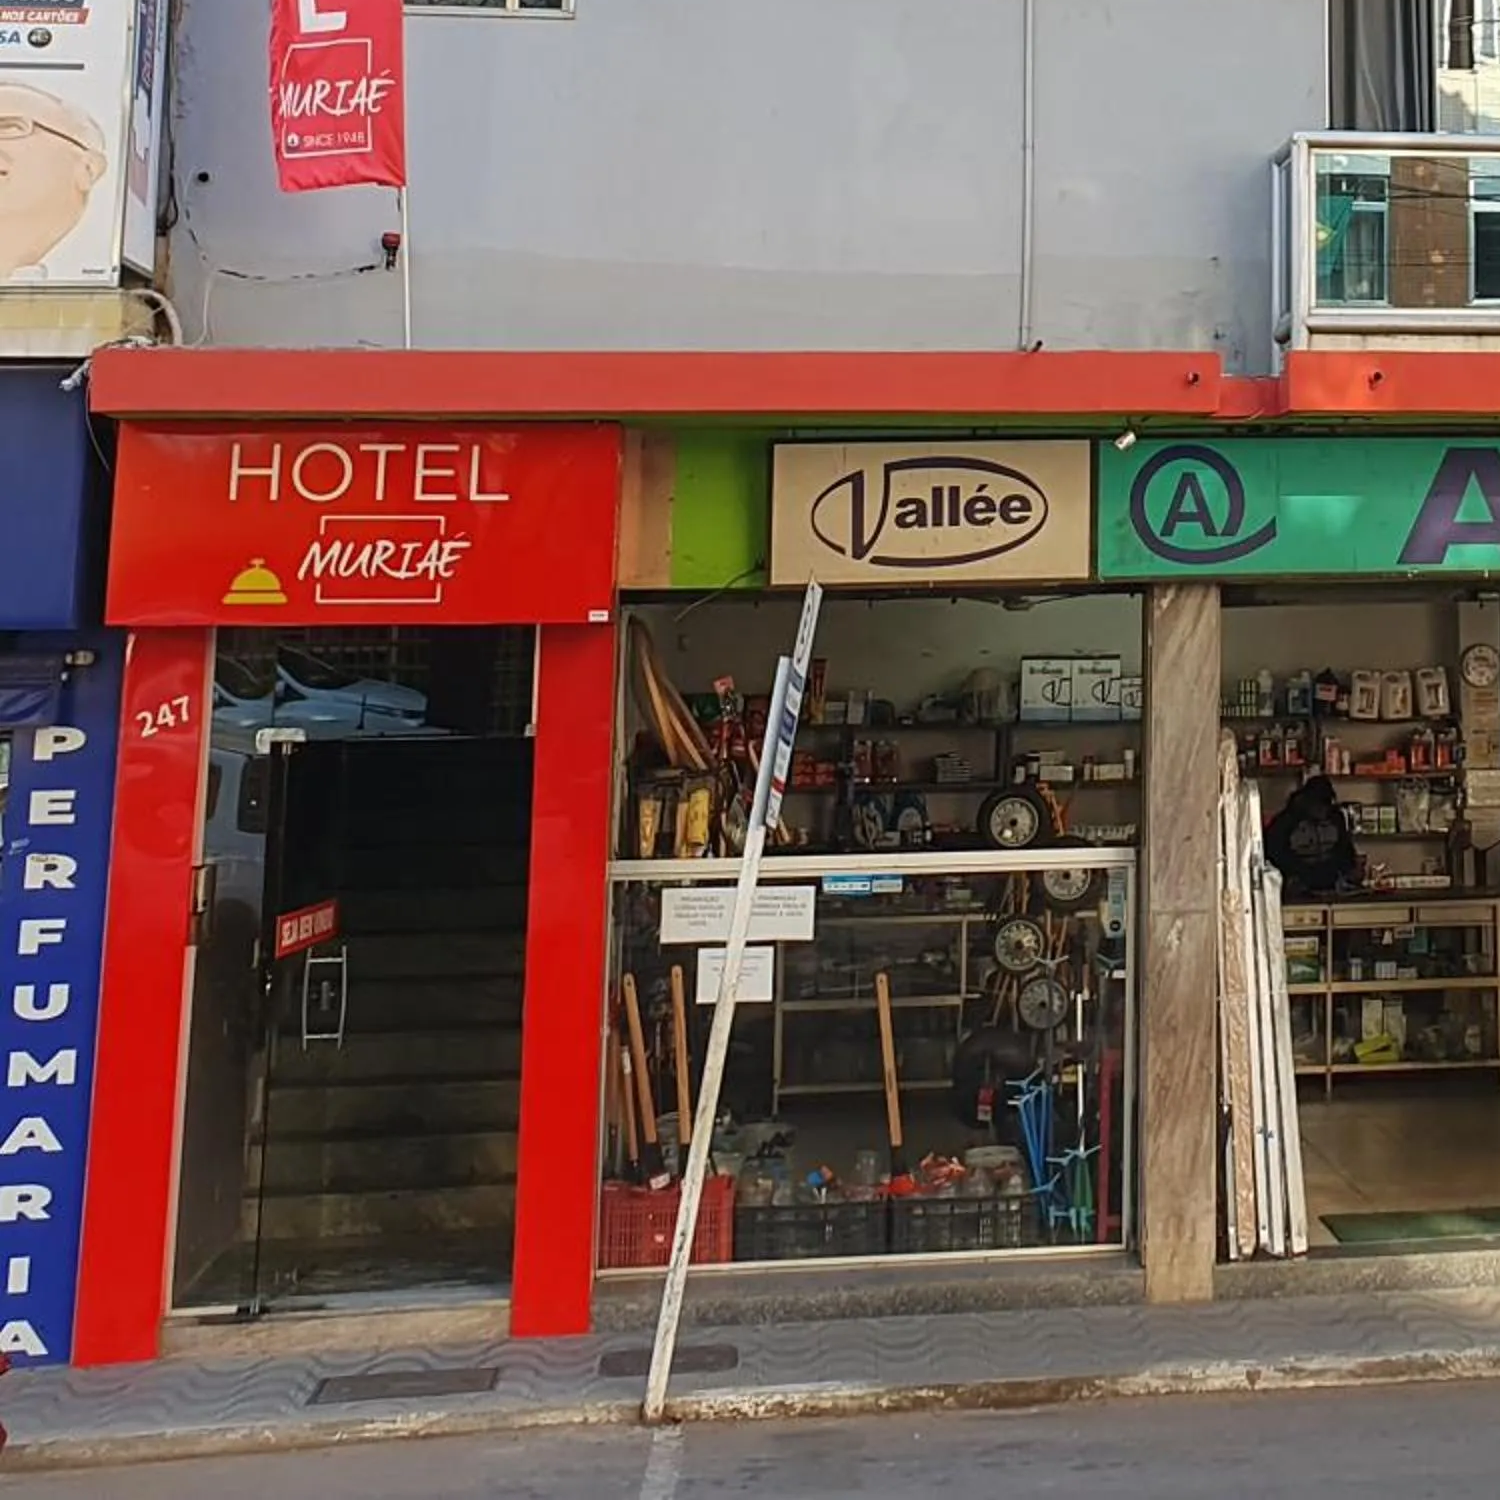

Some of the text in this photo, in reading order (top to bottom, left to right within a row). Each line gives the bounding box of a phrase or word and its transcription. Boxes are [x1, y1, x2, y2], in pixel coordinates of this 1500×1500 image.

[228, 443, 510, 502] HOTEL
[840, 463, 1033, 561] Vallée
[297, 531, 472, 581] MURIAÉ
[135, 695, 189, 738] 247
[0, 726, 86, 1357] PERFUMARIA
